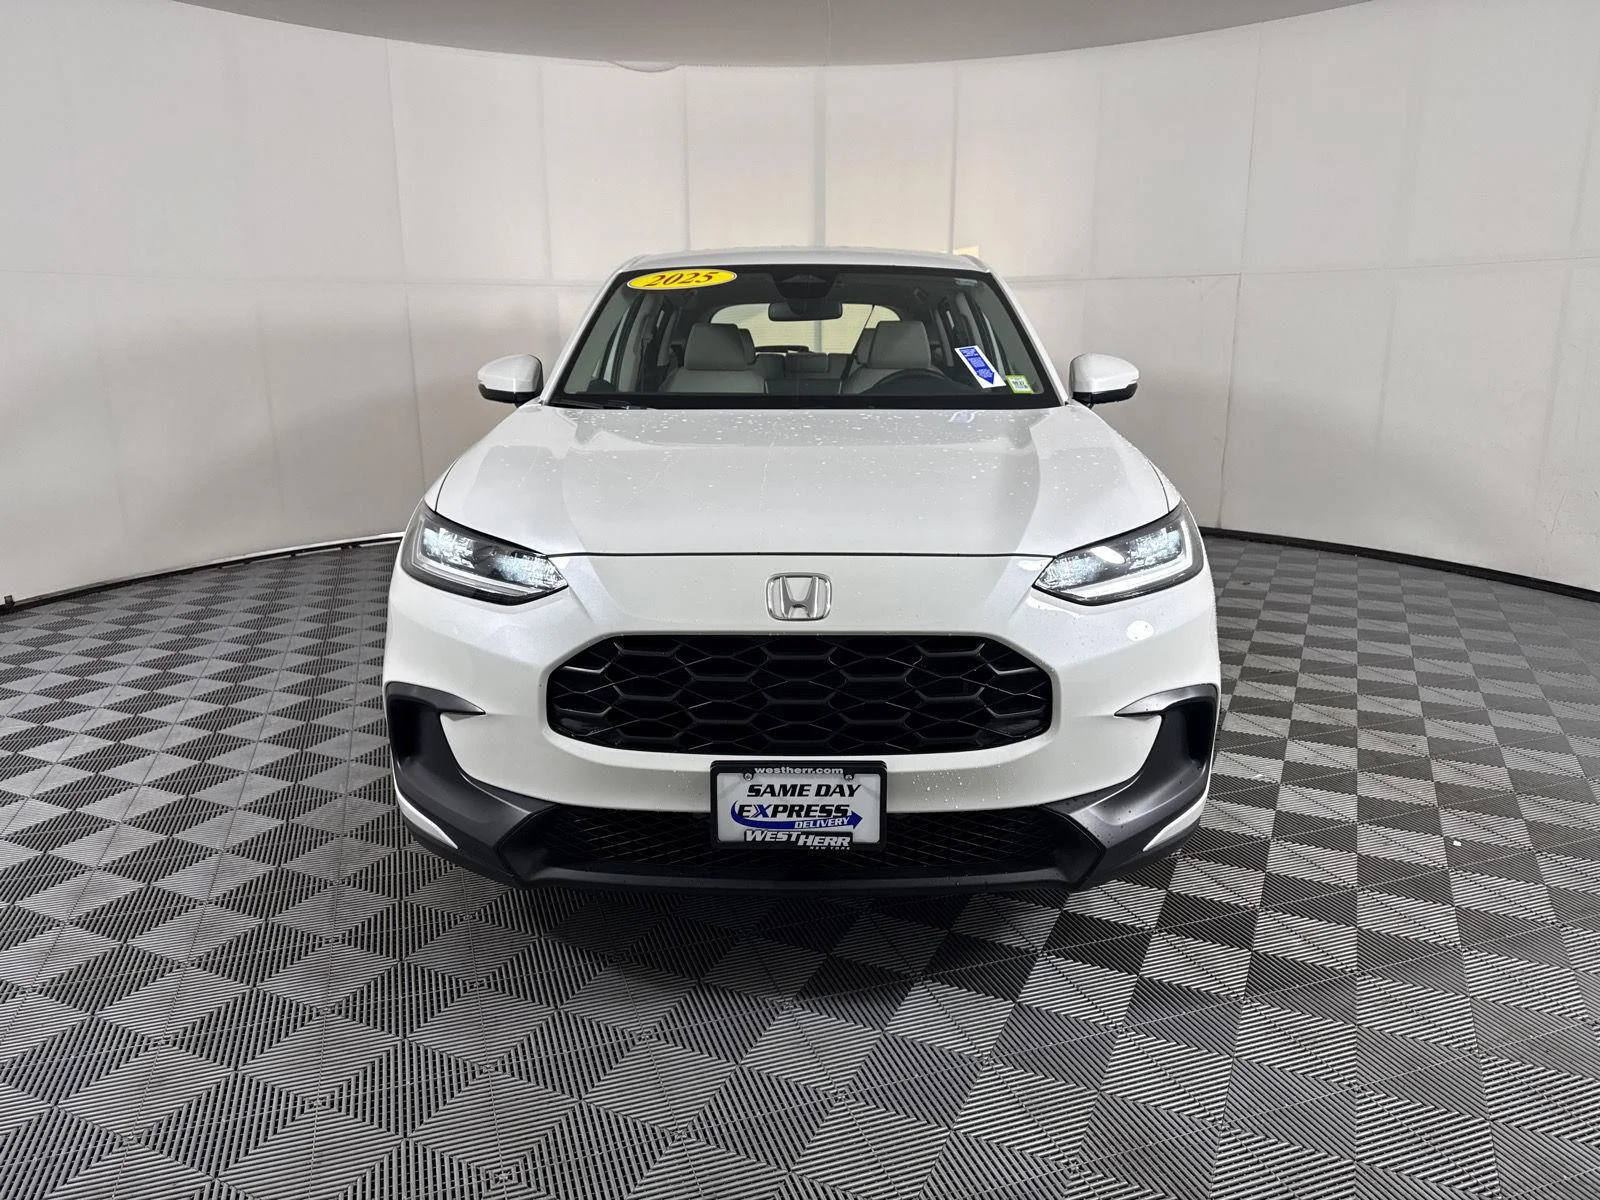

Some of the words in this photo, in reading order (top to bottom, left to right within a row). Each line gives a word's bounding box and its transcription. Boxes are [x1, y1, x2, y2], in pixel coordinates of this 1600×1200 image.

[643, 271, 719, 287] 2025
[747, 784, 812, 797] SAME
[815, 784, 861, 797] DAY
[738, 804, 850, 818] EXPRESS
[794, 816, 850, 829] DELIVERY
